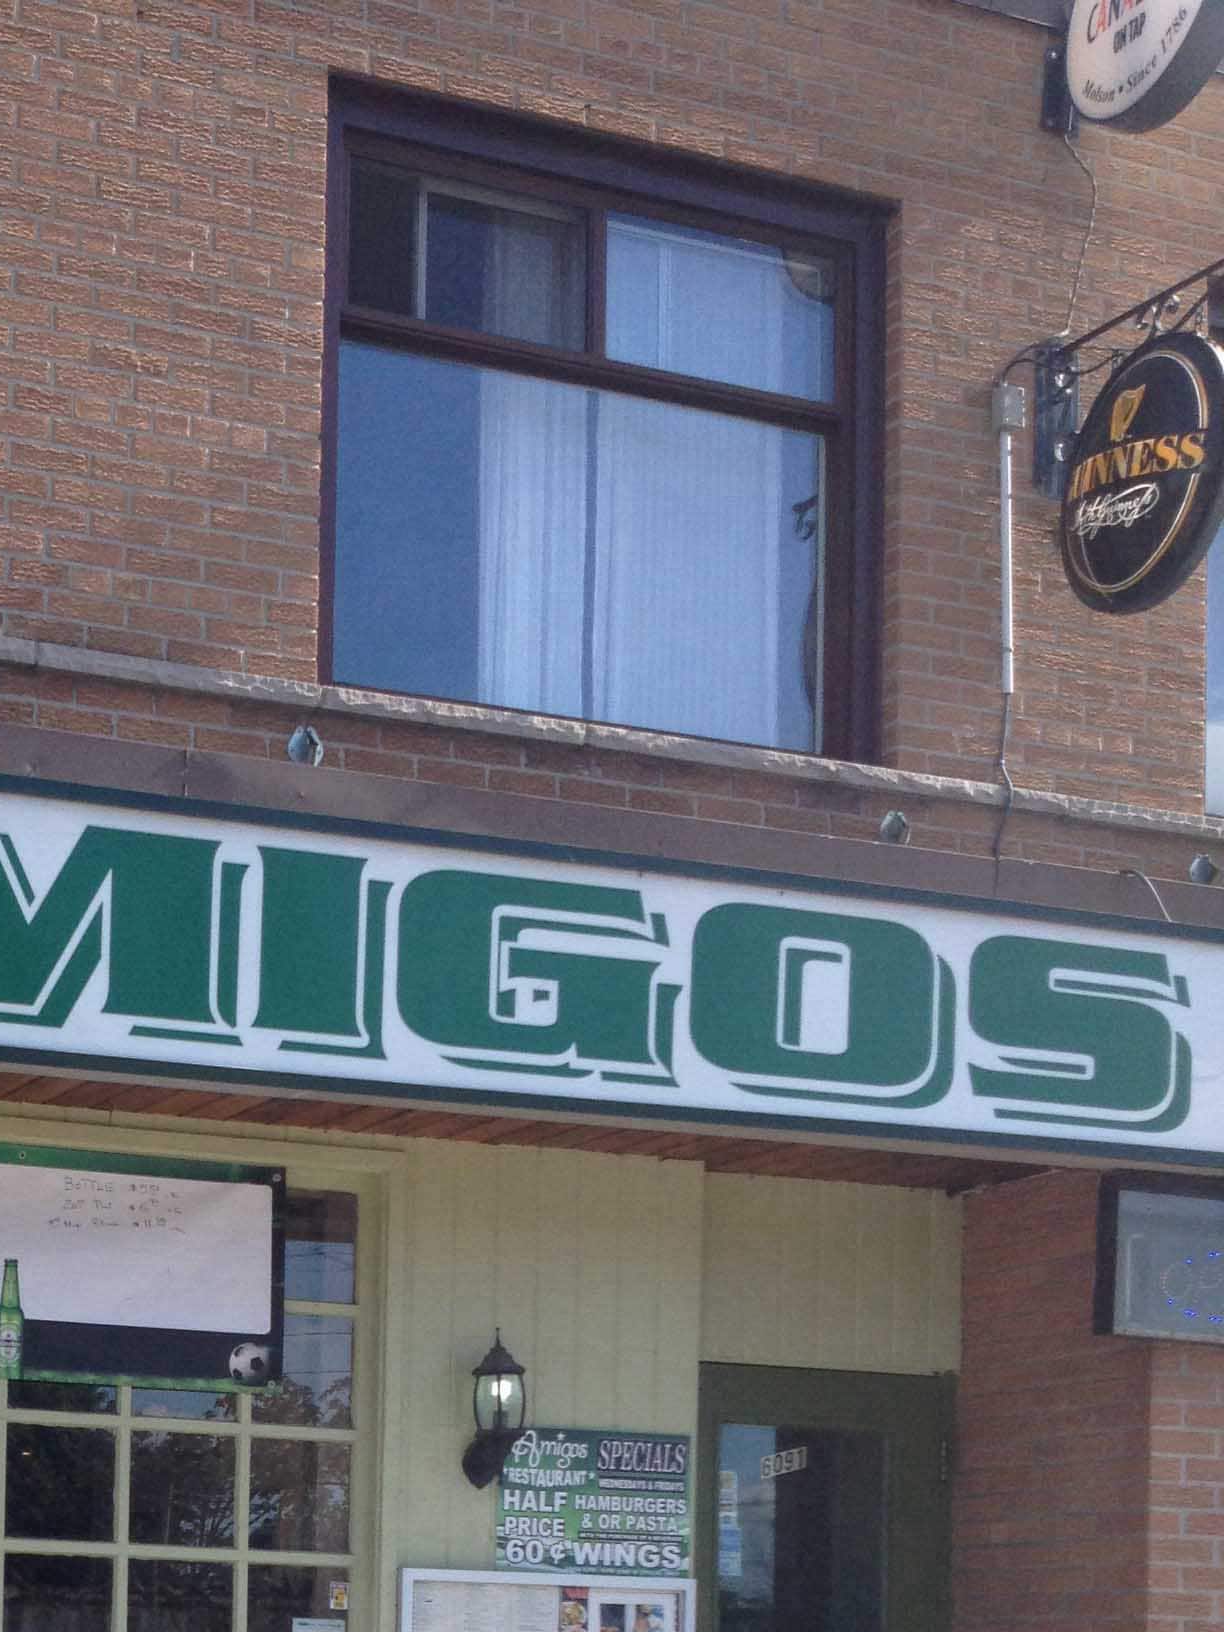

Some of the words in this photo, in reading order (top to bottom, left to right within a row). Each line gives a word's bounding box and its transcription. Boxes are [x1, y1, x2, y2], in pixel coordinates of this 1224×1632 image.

[1081, 79, 1115, 104] Molson
[1126, 54, 1158, 90] Since
[511, 1429, 589, 1469] Amigos
[597, 1439, 687, 1474] SPECIALS
[762, 1449, 805, 1478] 6091
[507, 1468, 588, 1488] RESTAURANT
[503, 1489, 569, 1513] HALF
[575, 1494, 687, 1515] HAMBURGERS
[504, 1516, 565, 1537] PRICE
[581, 1513, 593, 1529] &
[598, 1514, 621, 1531] OR
[626, 1514, 679, 1533] PASTA
[573, 1542, 682, 1569] WINGS
